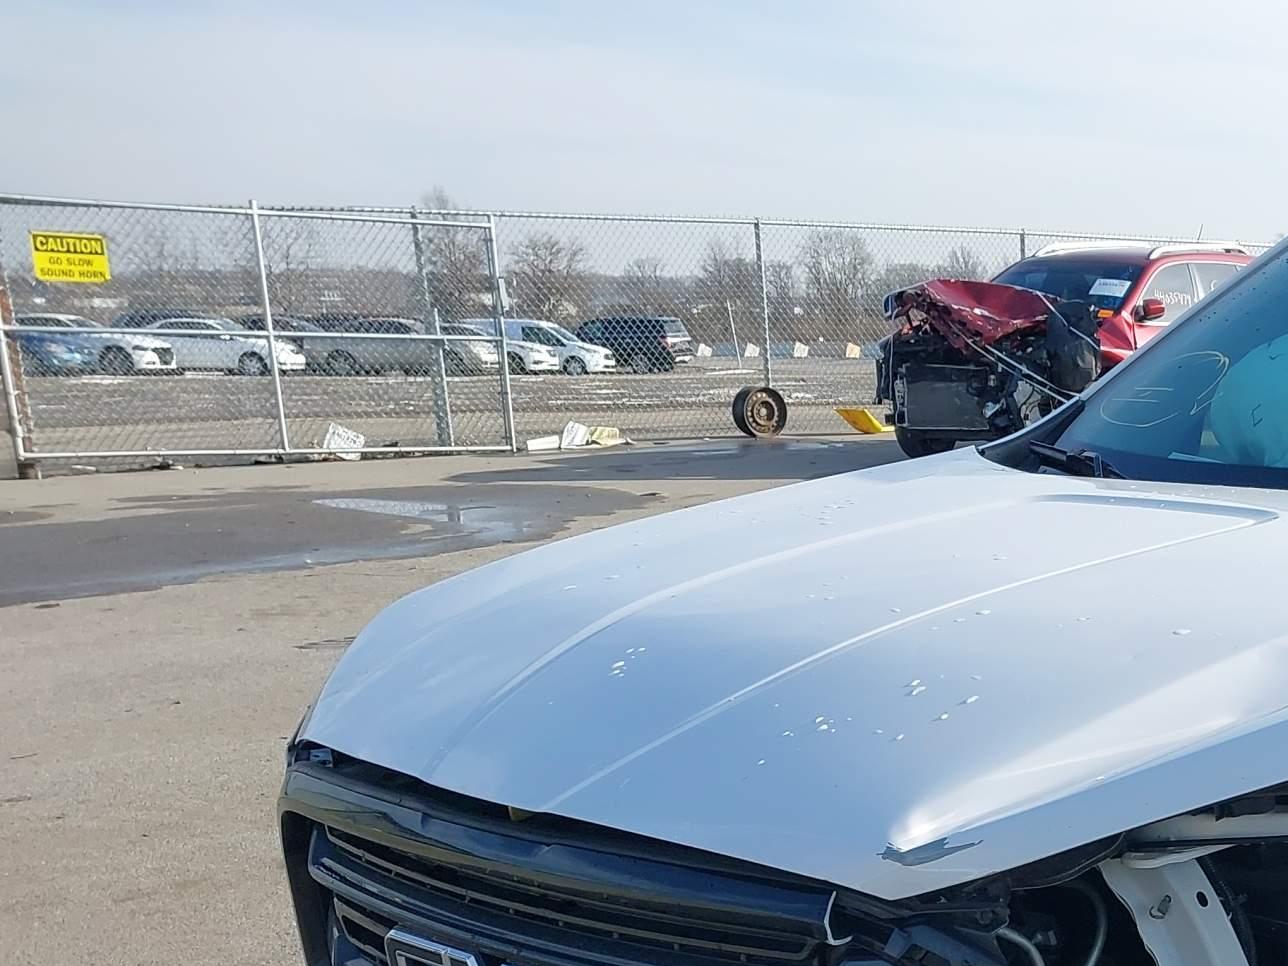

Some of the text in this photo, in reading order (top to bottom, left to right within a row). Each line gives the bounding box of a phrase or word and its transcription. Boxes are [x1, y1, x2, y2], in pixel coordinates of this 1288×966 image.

[36, 236, 103, 254] CAUTION
[48, 256, 94, 267] GO SLOW
[40, 267, 107, 281] SOUND HORN
